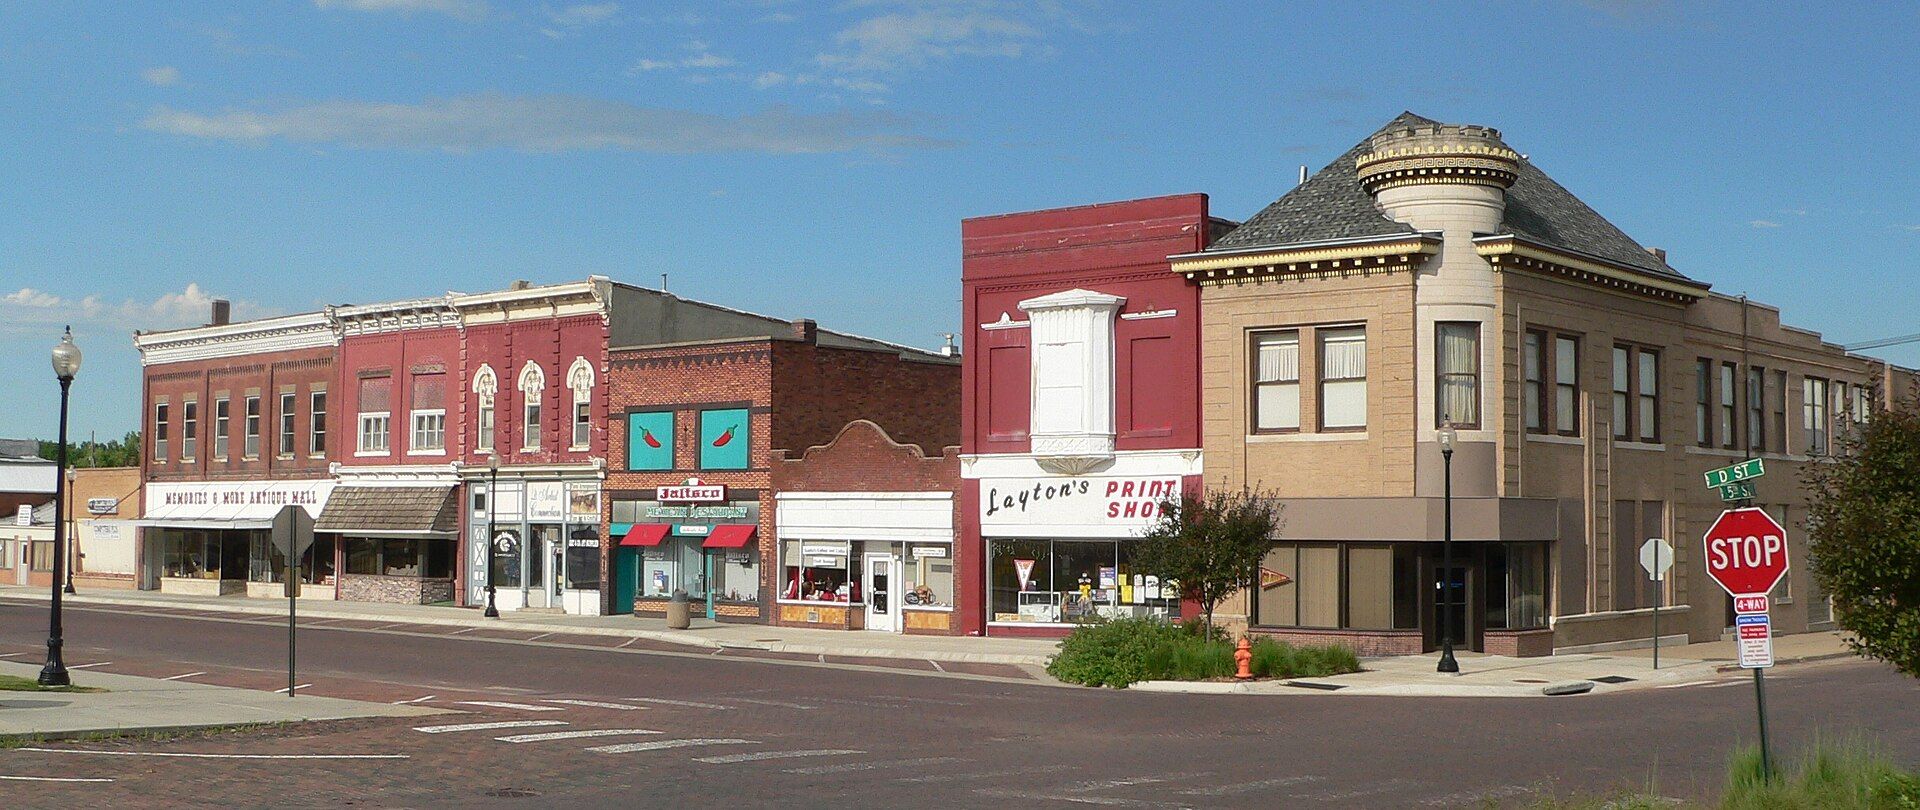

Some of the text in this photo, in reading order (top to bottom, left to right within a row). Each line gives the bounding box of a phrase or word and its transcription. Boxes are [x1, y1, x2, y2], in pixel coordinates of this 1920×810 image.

[1718, 463, 1749, 483] D ST
[659, 487, 721, 499] Jalisco
[1105, 480, 1177, 497] PRINT
[165, 491, 208, 505] MEMORIES
[223, 491, 245, 505] MORE
[249, 491, 287, 505] ANTIQUE
[291, 490, 317, 504] MALL
[986, 479, 1090, 516] Layton's
[1711, 535, 1781, 570] STOP
[1737, 599, 1765, 610] 4-WAY
